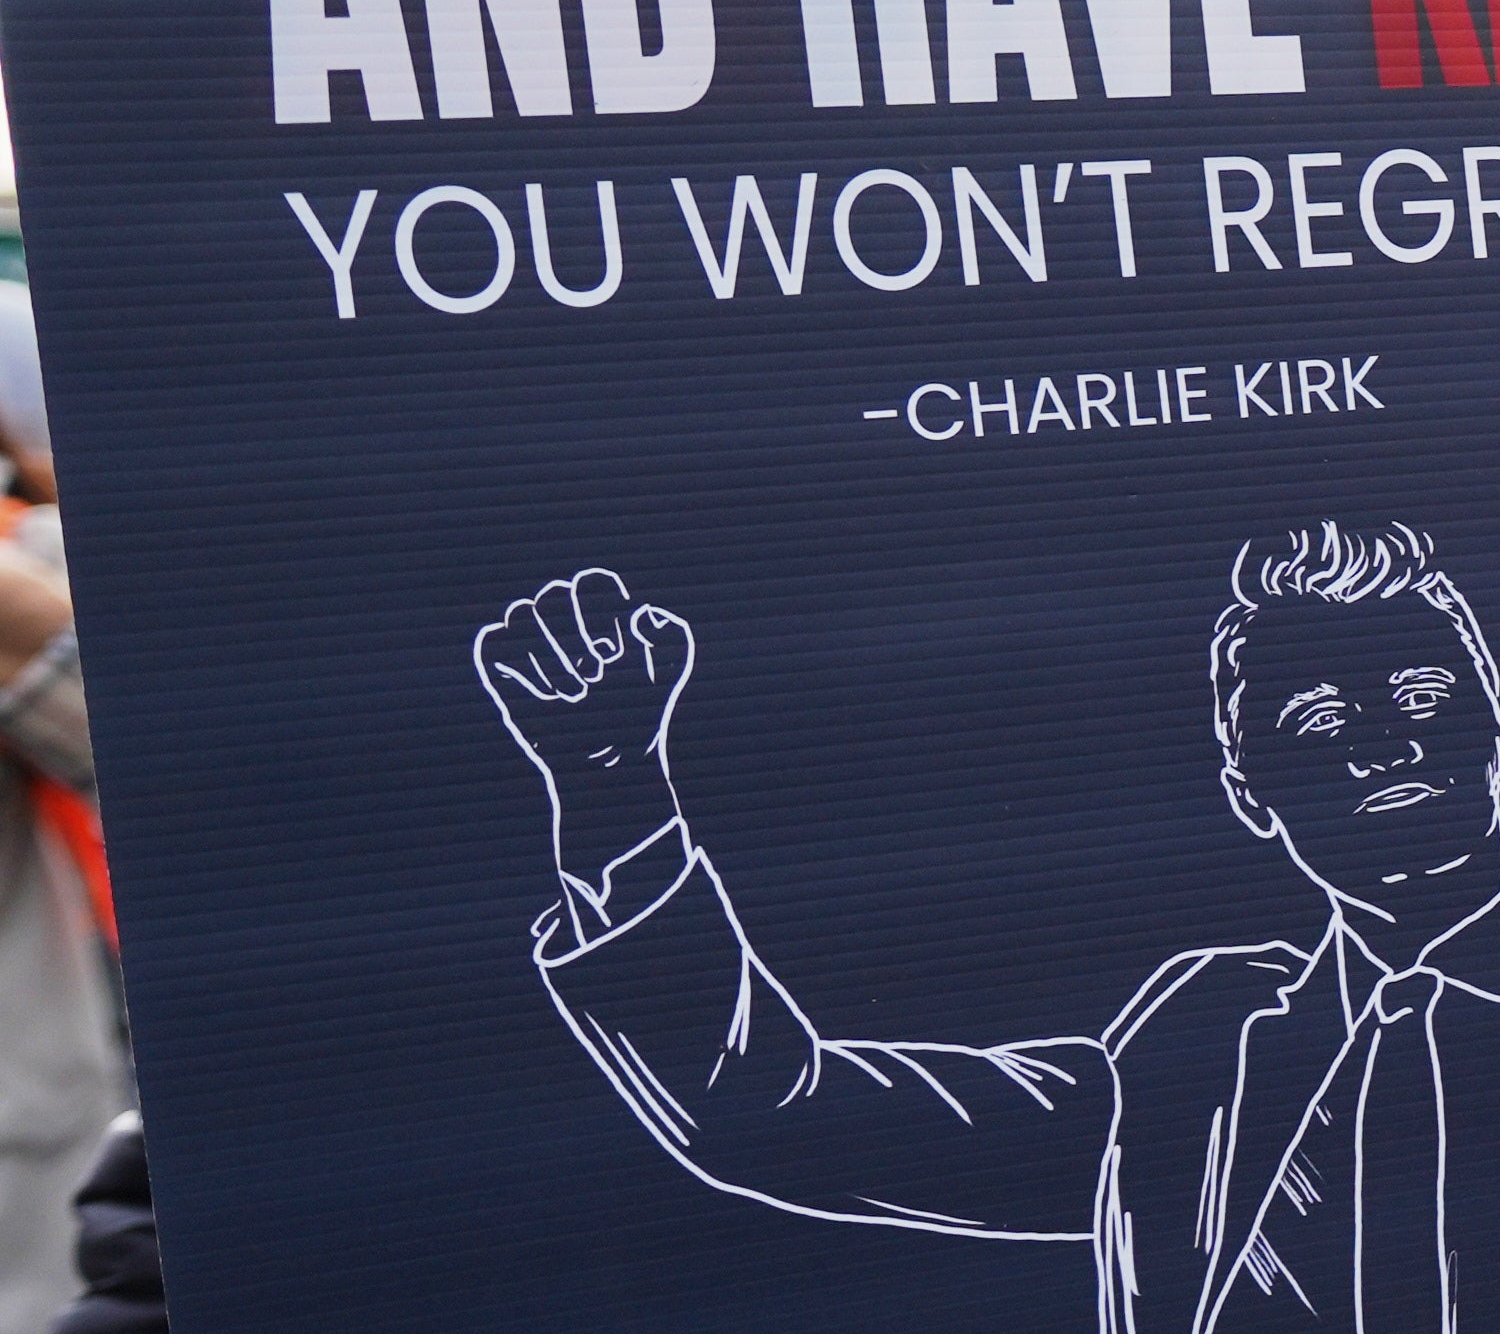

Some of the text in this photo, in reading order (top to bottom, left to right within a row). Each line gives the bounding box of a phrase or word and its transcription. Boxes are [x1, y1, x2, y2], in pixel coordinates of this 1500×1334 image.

[283, 180, 624, 319] YOU
[670, 159, 1153, 300] WON’T
[863, 355, 1385, 441] -CHARLIE KIRK
